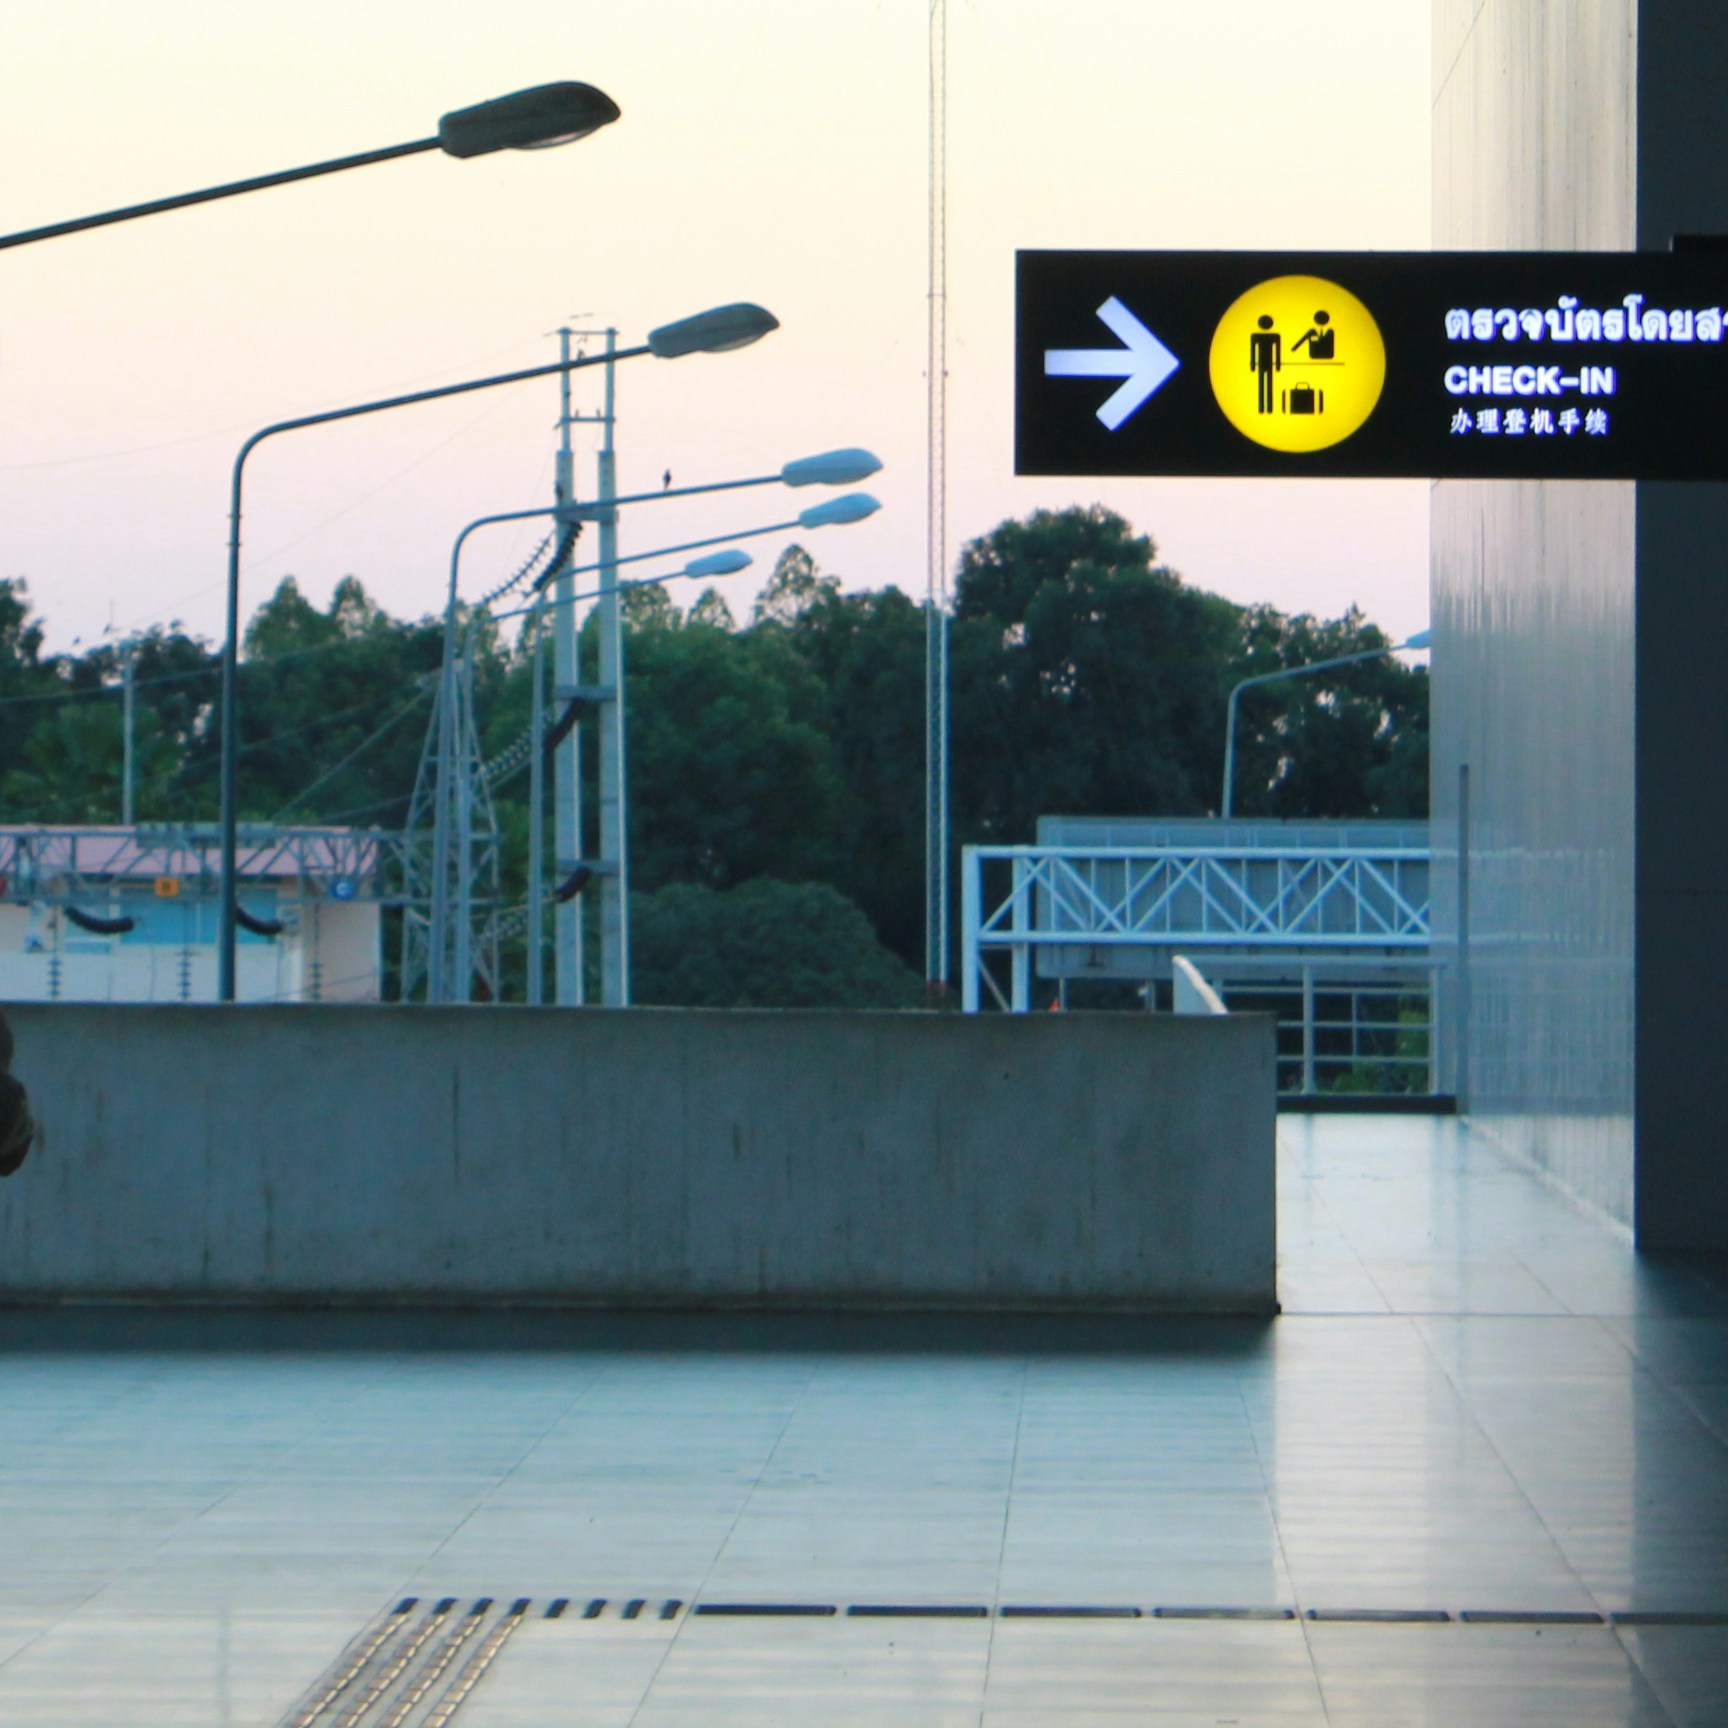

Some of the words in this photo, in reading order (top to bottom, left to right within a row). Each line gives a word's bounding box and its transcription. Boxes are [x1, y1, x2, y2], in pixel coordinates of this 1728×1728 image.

[1445, 366, 1615, 396] CHECK-IN
[1449, 407, 1609, 437] 办理登机手续
